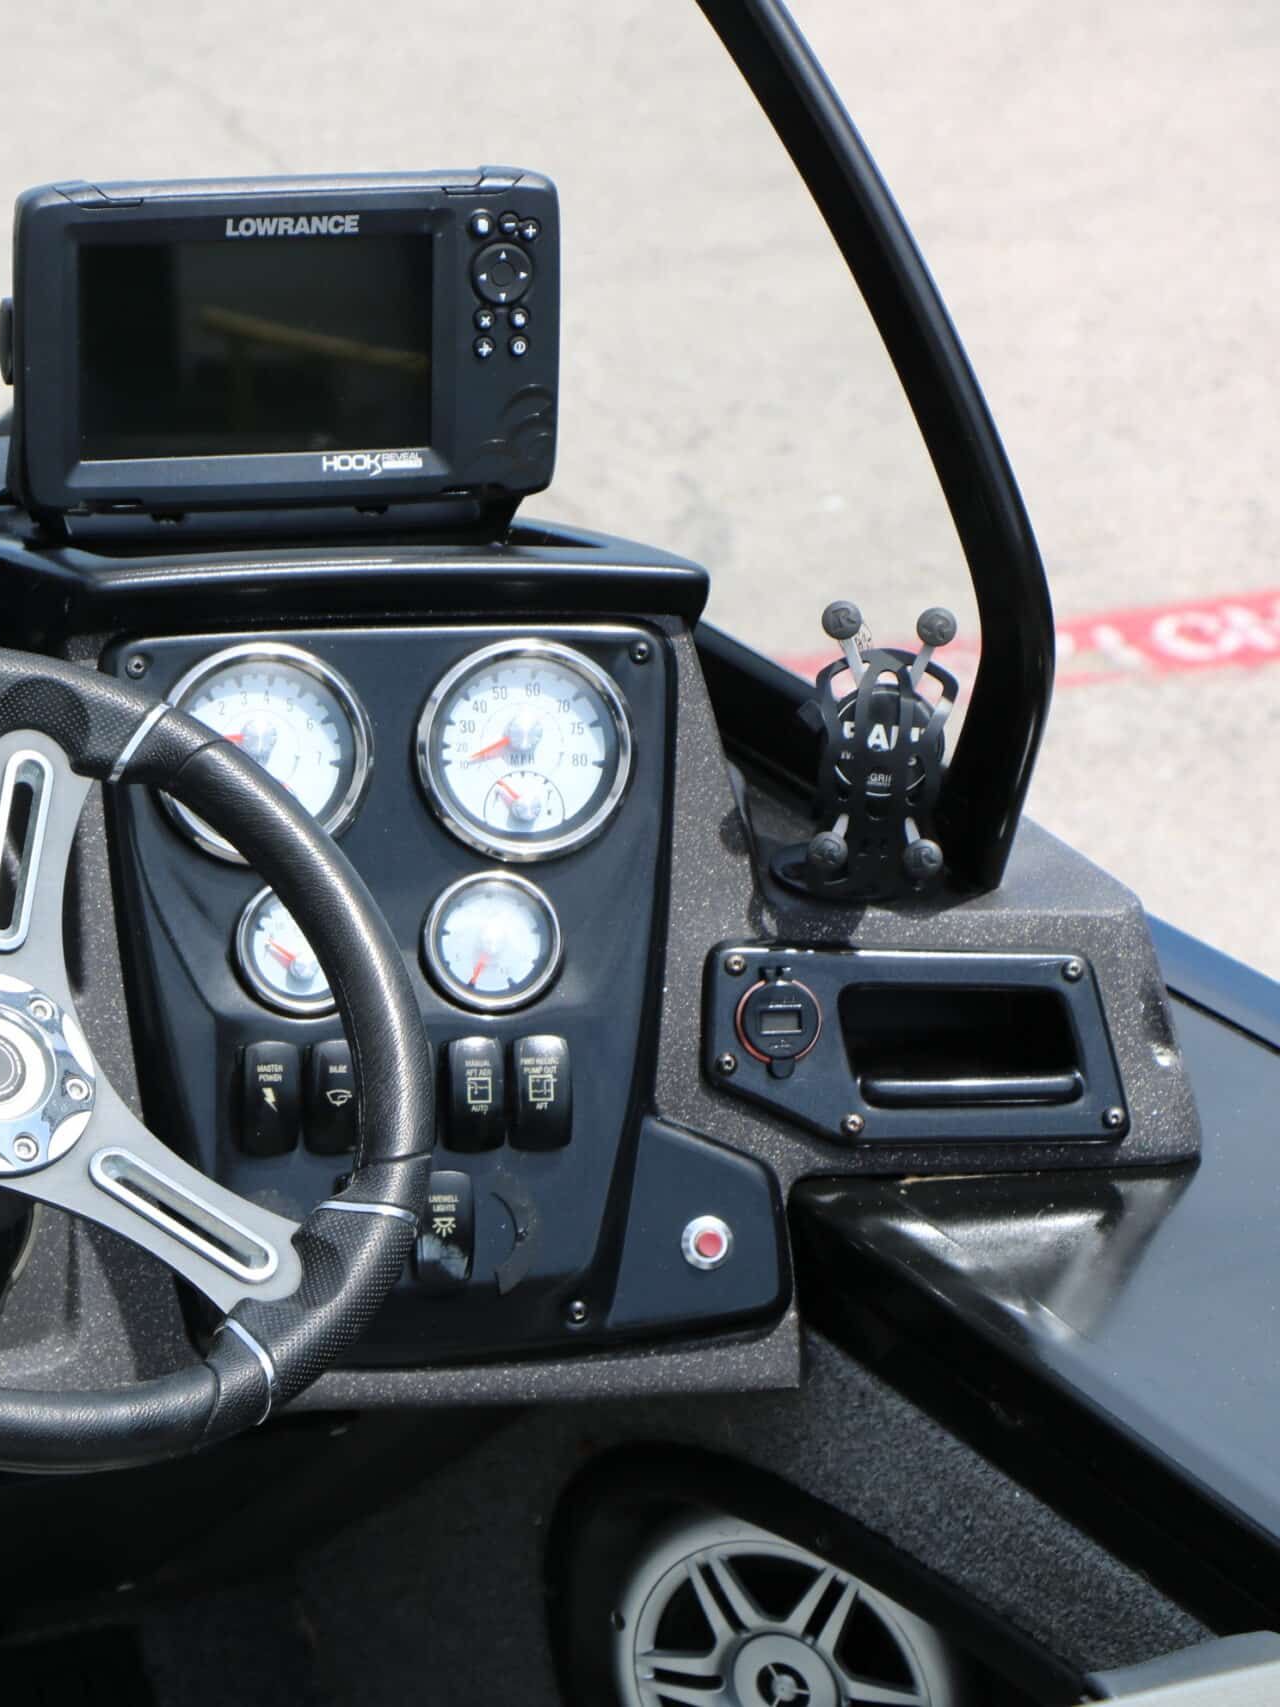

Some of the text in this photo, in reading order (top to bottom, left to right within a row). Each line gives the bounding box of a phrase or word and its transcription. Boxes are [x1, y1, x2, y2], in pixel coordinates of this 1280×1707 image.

[225, 214, 360, 238] LOWRANCE
[322, 453, 382, 477] HOOK
[240, 690, 248, 705] 3
[491, 685, 508, 700] 50
[525, 682, 541, 698] 60
[472, 699, 488, 714] 40
[459, 719, 476, 735] 30
[570, 722, 585, 736] 75
[572, 752, 588, 768] 80
[257, 1064, 283, 1073] MASTER
[258, 1073, 283, 1082] POWER
[471, 1104, 489, 1113] AUTO
